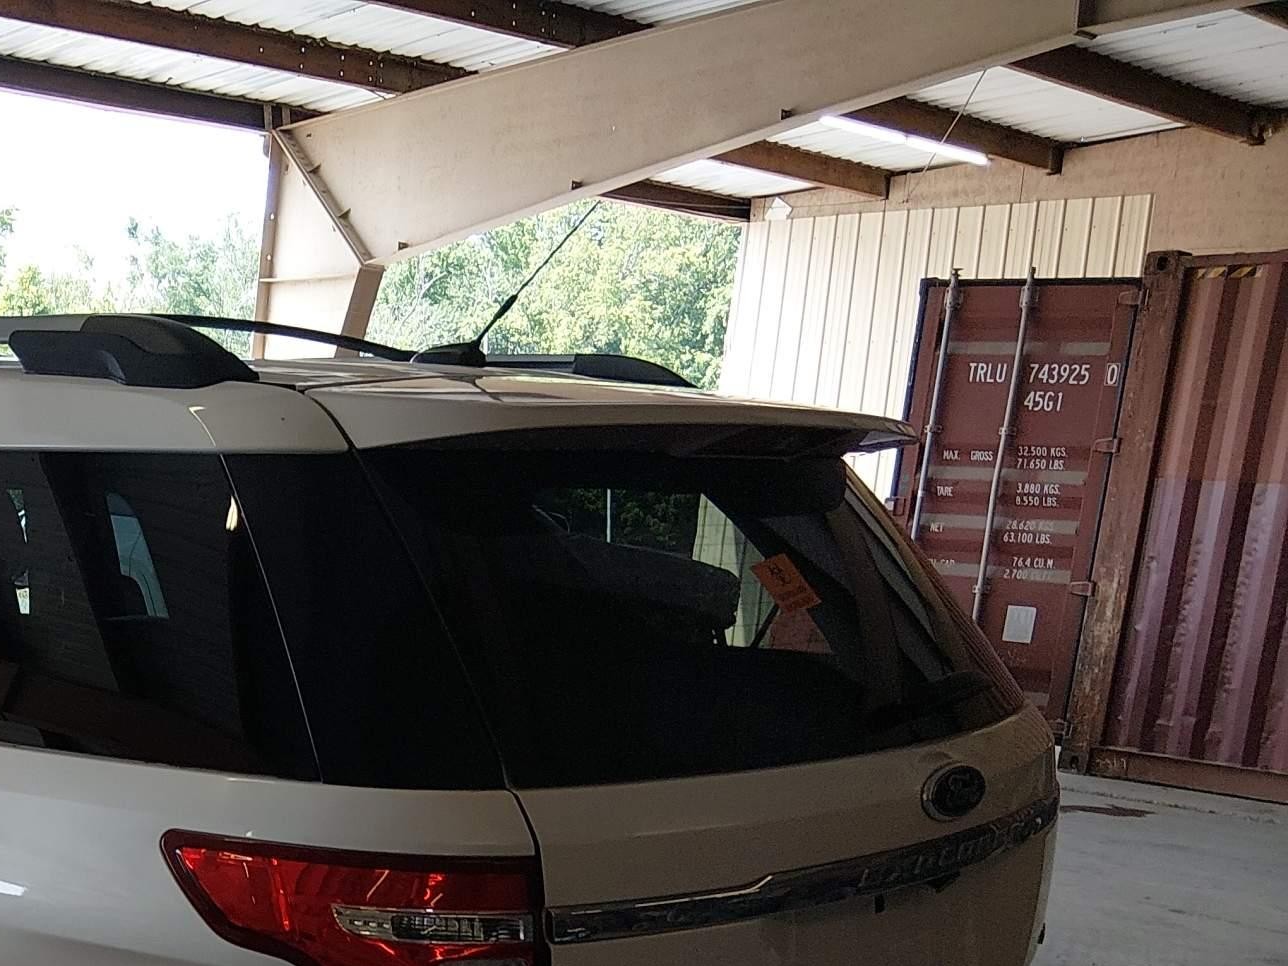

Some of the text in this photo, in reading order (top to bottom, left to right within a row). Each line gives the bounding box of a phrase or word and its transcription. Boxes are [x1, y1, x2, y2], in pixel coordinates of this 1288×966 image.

[968, 362, 1119, 386] TRLU 743925 0
[1023, 391, 1064, 412] 45G1
[970, 450, 994, 462] GROSS
[1017, 446, 1048, 457] 32.500
[1016, 458, 1047, 470] 71.650
[936, 485, 954, 498] TARE
[929, 522, 945, 533] NET
[1003, 532, 1033, 544] 63.100
[1012, 556, 1031, 568] 76.4
